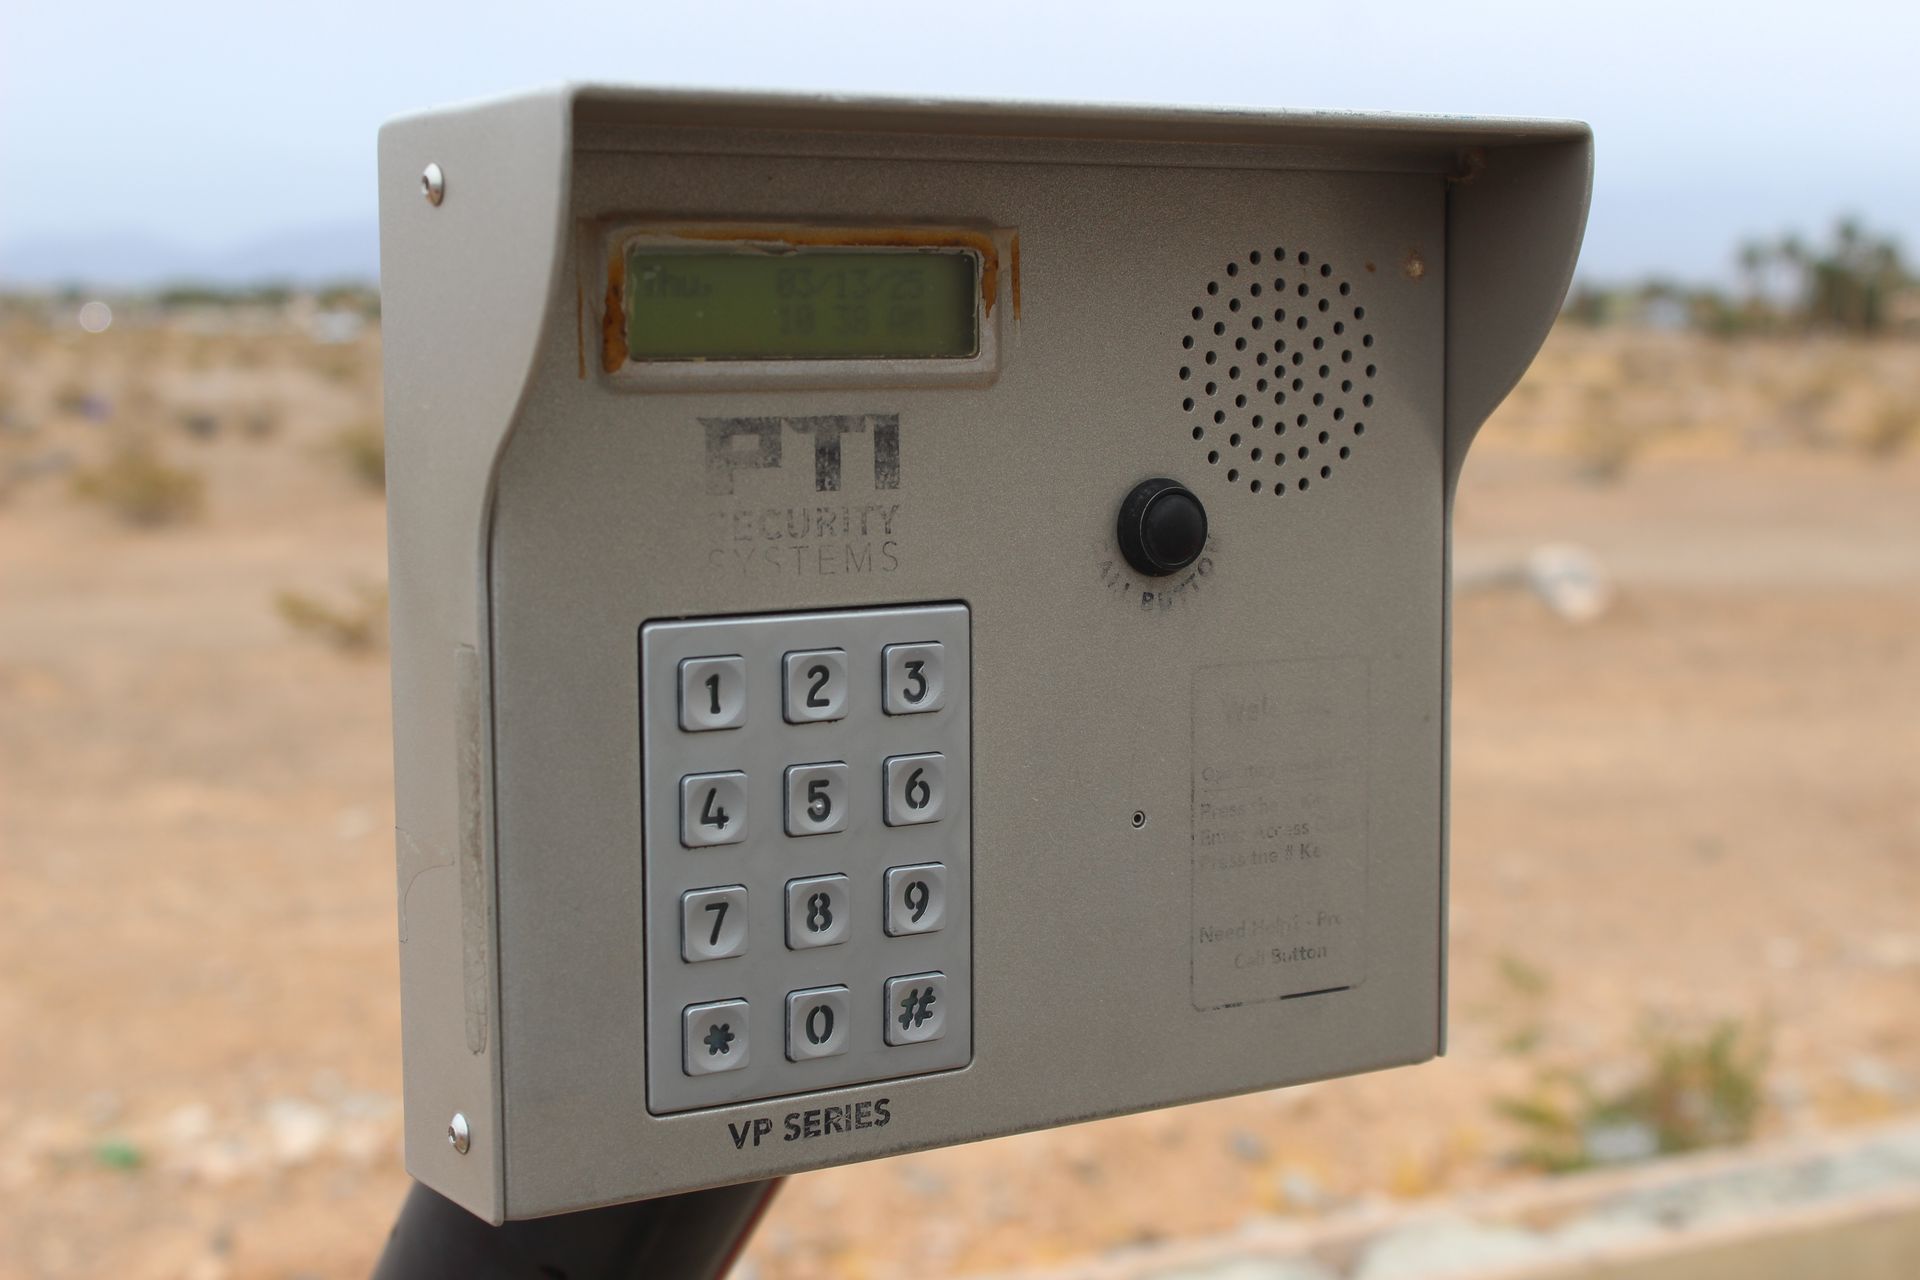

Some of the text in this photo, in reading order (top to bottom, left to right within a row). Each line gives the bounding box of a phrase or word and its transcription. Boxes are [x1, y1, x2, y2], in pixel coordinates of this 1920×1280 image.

[697, 413, 900, 496] PTI
[709, 504, 900, 542] ECURITY
[705, 673, 720, 714] 1
[806, 664, 831, 708] 2
[903, 660, 928, 704] 3
[701, 788, 729, 829] 4
[807, 779, 832, 823] 5
[904, 767, 931, 810] 6
[806, 892, 833, 932] 8
[904, 881, 930, 923] 9
[705, 902, 729, 946] 7
[805, 1005, 834, 1045] 0
[898, 986, 936, 1031] #
[727, 1097, 891, 1150] VP SERIES
